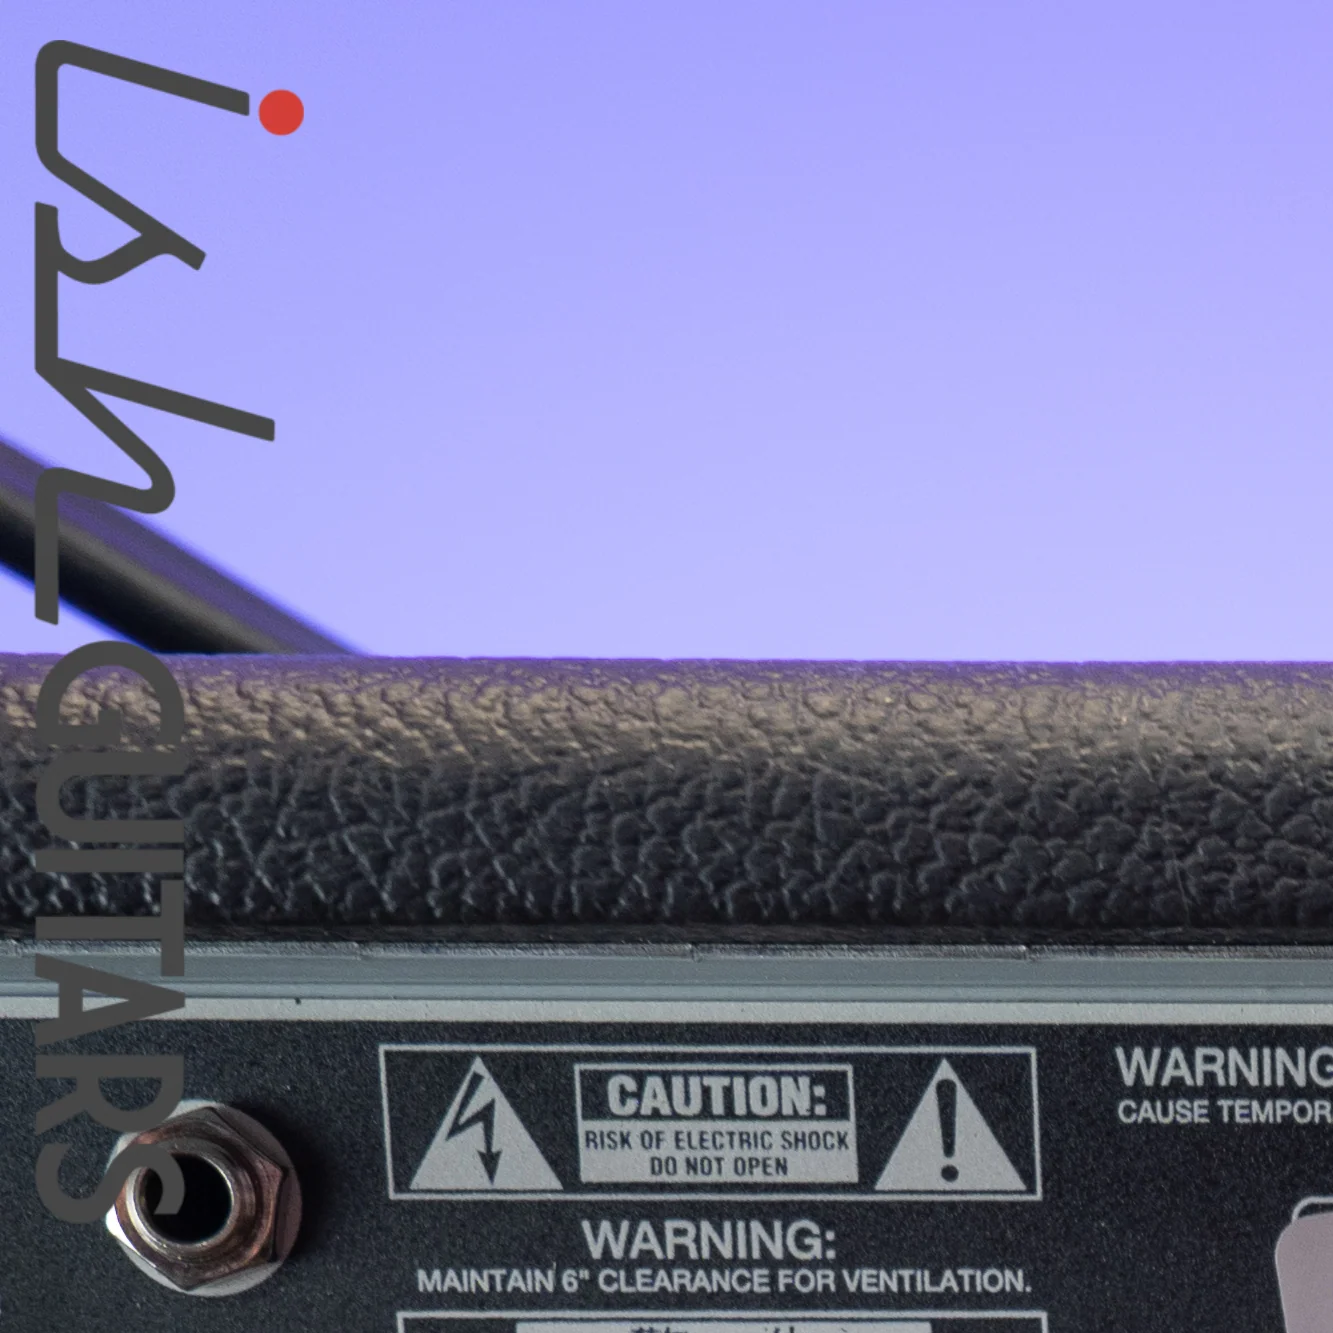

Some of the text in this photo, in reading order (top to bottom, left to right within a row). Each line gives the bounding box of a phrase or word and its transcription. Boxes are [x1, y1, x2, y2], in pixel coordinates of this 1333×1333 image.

[606, 1074, 827, 1117] CAUTION:
[1116, 1098, 1210, 1125] CAUSE
[585, 1129, 850, 1152] RISK OF ELECTRIC SHOCK
[650, 1155, 789, 1178] DO NOT OPEN
[580, 1218, 837, 1261] WARNING:
[416, 1267, 1033, 1294] MAINTAIN 6" CLEARANCE FOR VENTILATION.
